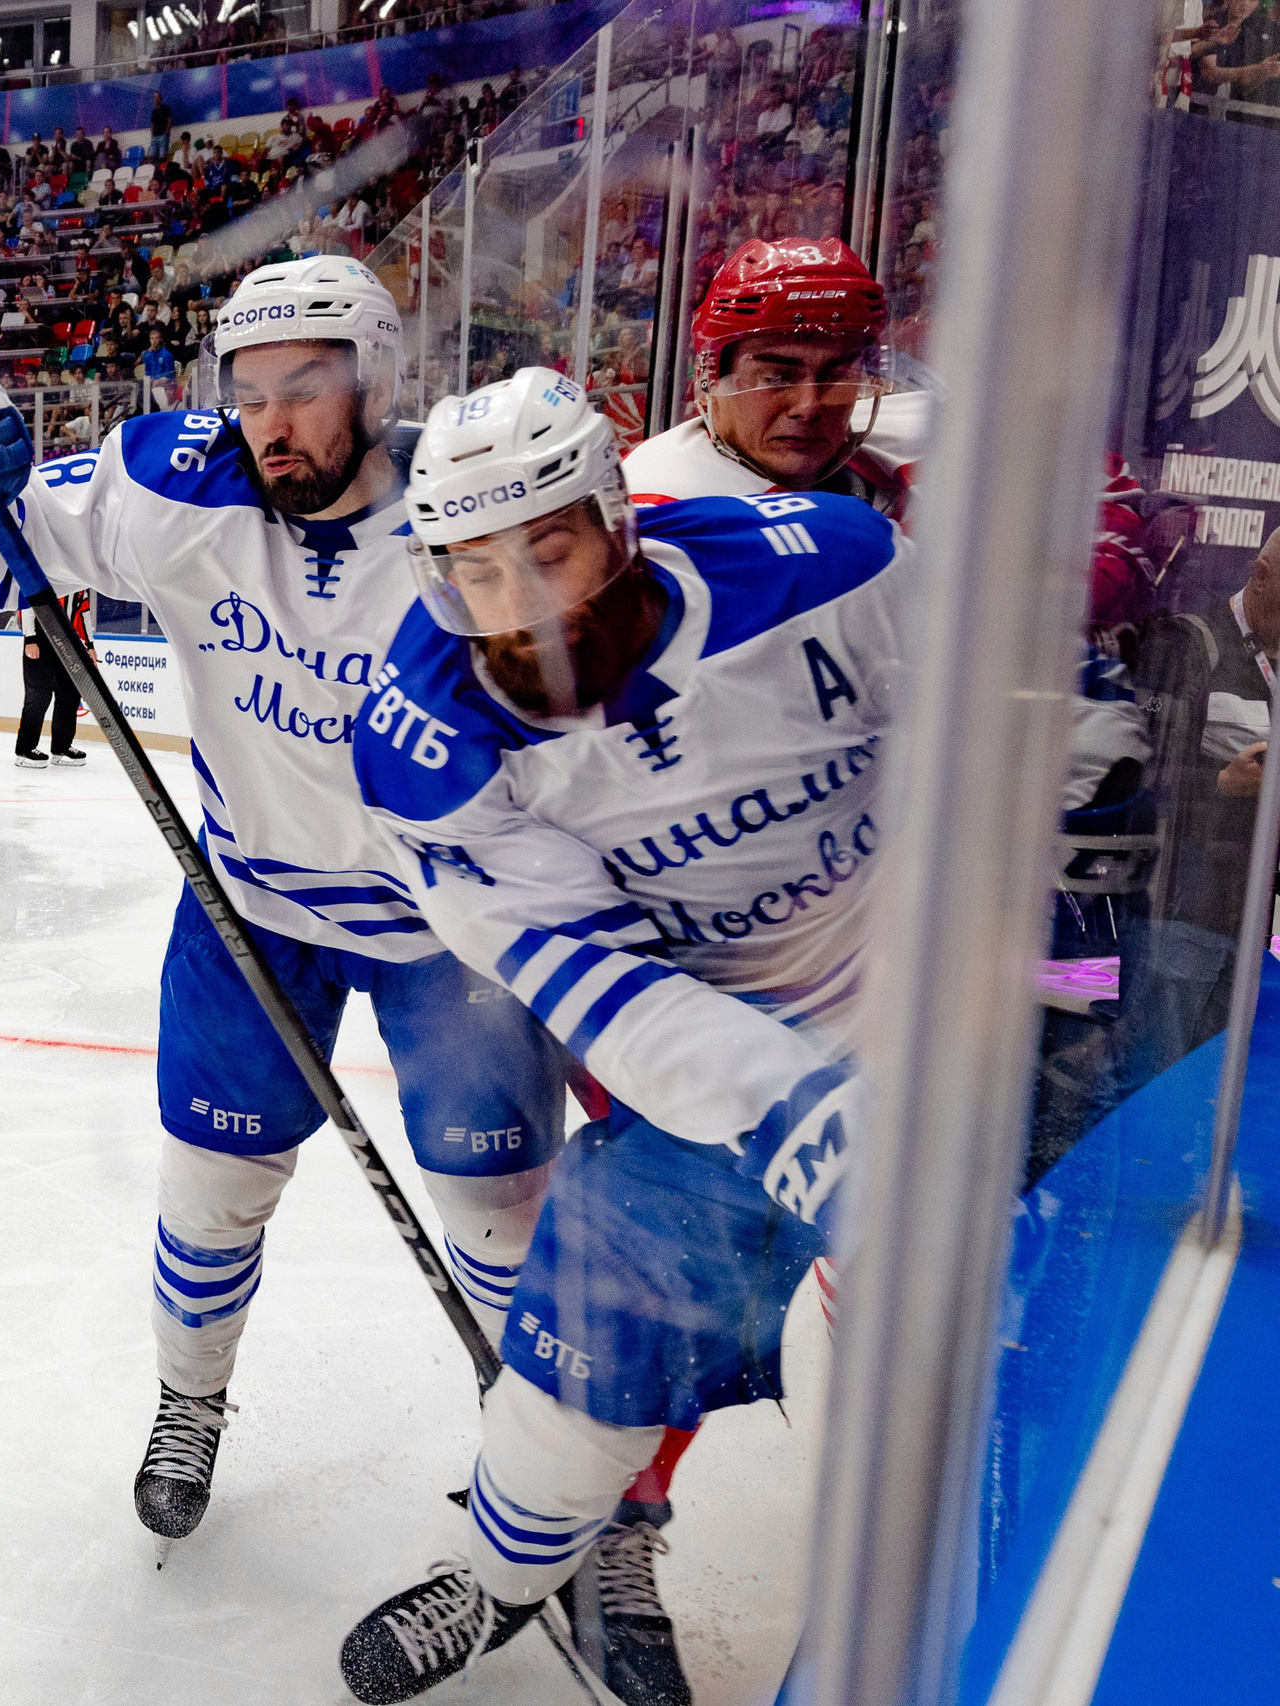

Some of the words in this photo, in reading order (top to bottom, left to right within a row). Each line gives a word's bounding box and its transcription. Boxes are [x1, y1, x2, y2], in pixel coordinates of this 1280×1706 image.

[786, 289, 848, 301] BAUER
[377, 320, 400, 334] CCM
[170, 413, 224, 472] ВТБ
[104, 650, 167, 671] Федерация
[802, 636, 858, 722] A
[117, 680, 154, 694] хоккея
[234, 673, 357, 745] Моск
[367, 685, 460, 770] ВТБ
[145, 799, 250, 958] RIBCOR
[213, 1108, 262, 1135] ВТБ
[470, 1126, 523, 1153] ВТБ
[534, 1329, 594, 1379] ВТБ
